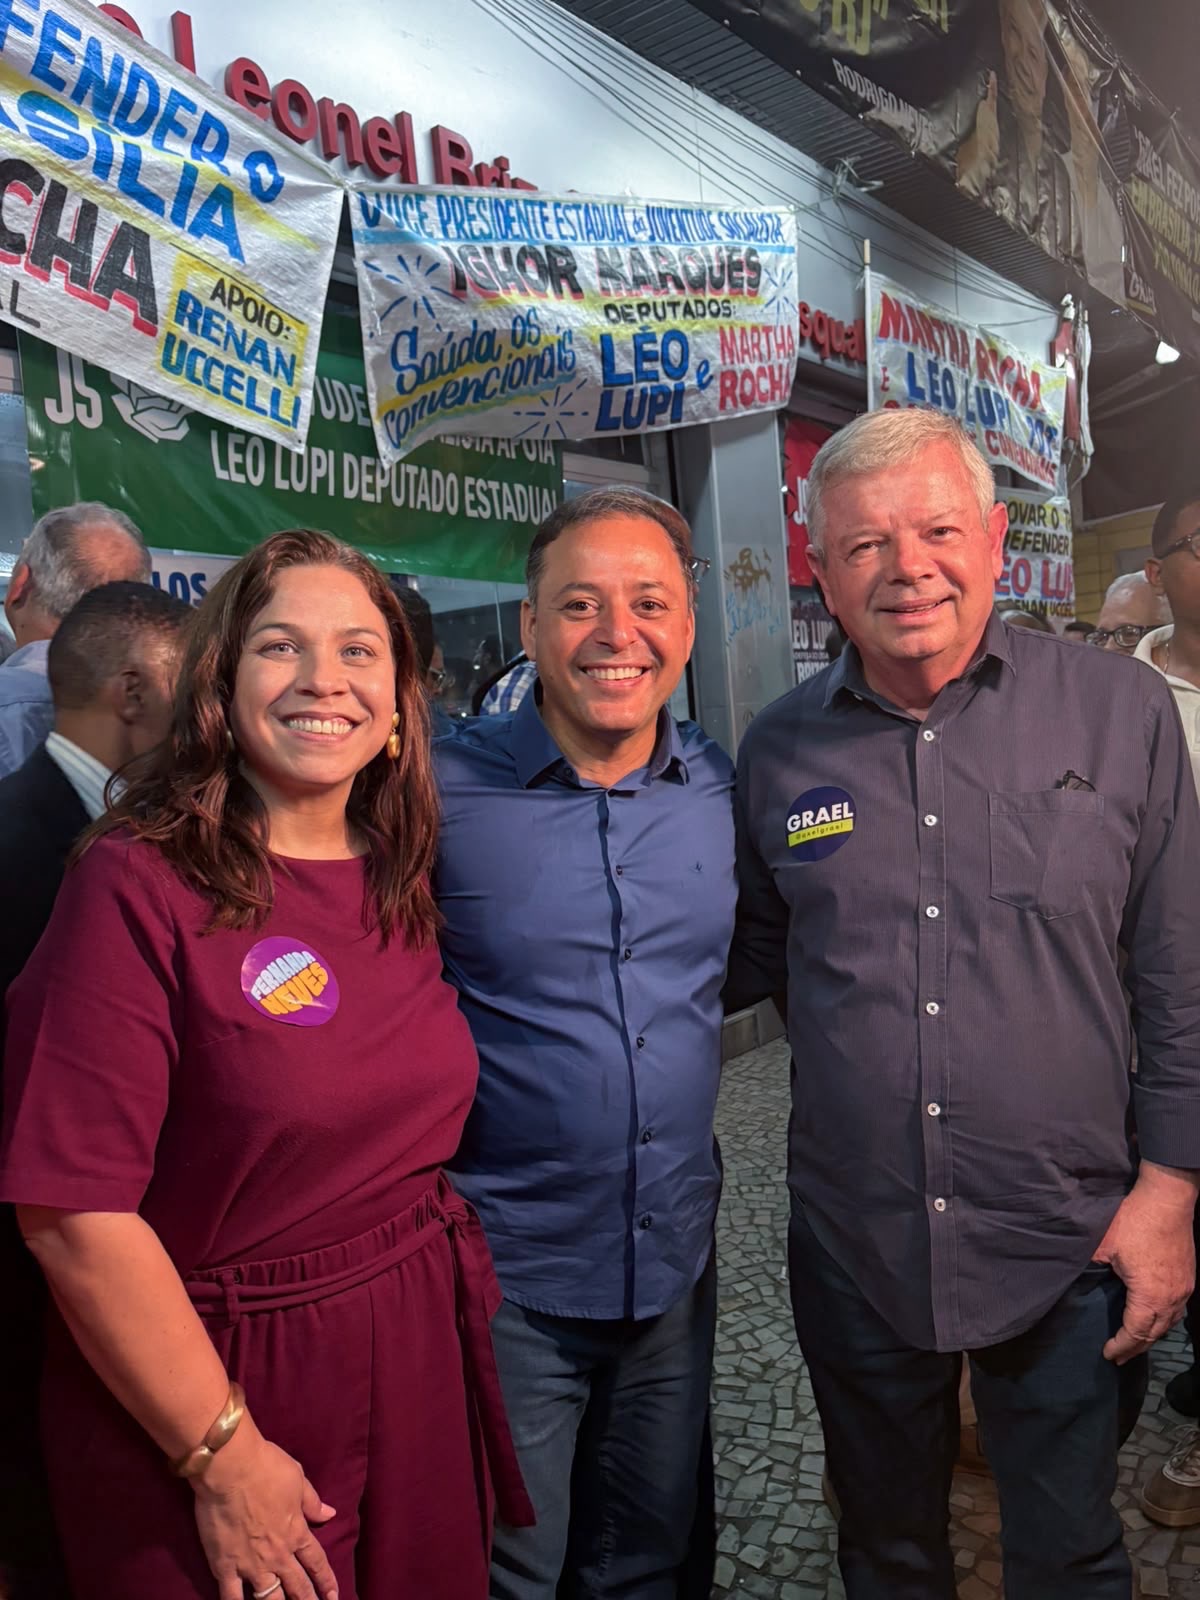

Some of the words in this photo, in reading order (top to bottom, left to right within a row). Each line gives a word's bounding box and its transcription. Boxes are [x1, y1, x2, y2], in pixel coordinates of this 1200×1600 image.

[832, 57, 898, 114] RODRIGO
[0, 90, 246, 265] SILIA
[243, 150, 285, 203] O
[436, 193, 551, 241] PRESIDENTE
[553, 202, 637, 244] ESTADUAL
[646, 204, 722, 243] JUVENTUDE
[717, 210, 785, 244] SOCIALISTA
[595, 245, 763, 298] MARQUES
[210, 277, 292, 340] APOIO:
[603, 299, 737, 325] DEPUTADOS:
[878, 291, 971, 379] MARTHA
[173, 288, 297, 388] RENAN
[600, 324, 690, 388] LÉO
[718, 324, 796, 367] MARTHA
[161, 331, 302, 429] UCCELLI
[311, 375, 372, 428] UDE
[594, 380, 686, 432] LUPI
[718, 366, 792, 412] ROCHA
[880, 366, 891, 393] E
[274, 443, 336, 497] LUPI
[342, 452, 459, 517] DEPUTADO
[1005, 500, 1048, 529] OVAR
[786, 801, 854, 832] GRAEL
[796, 822, 844, 840] @axelgrael
[250, 950, 317, 1001] FERNANDA
[260, 961, 329, 1016] NEVES
